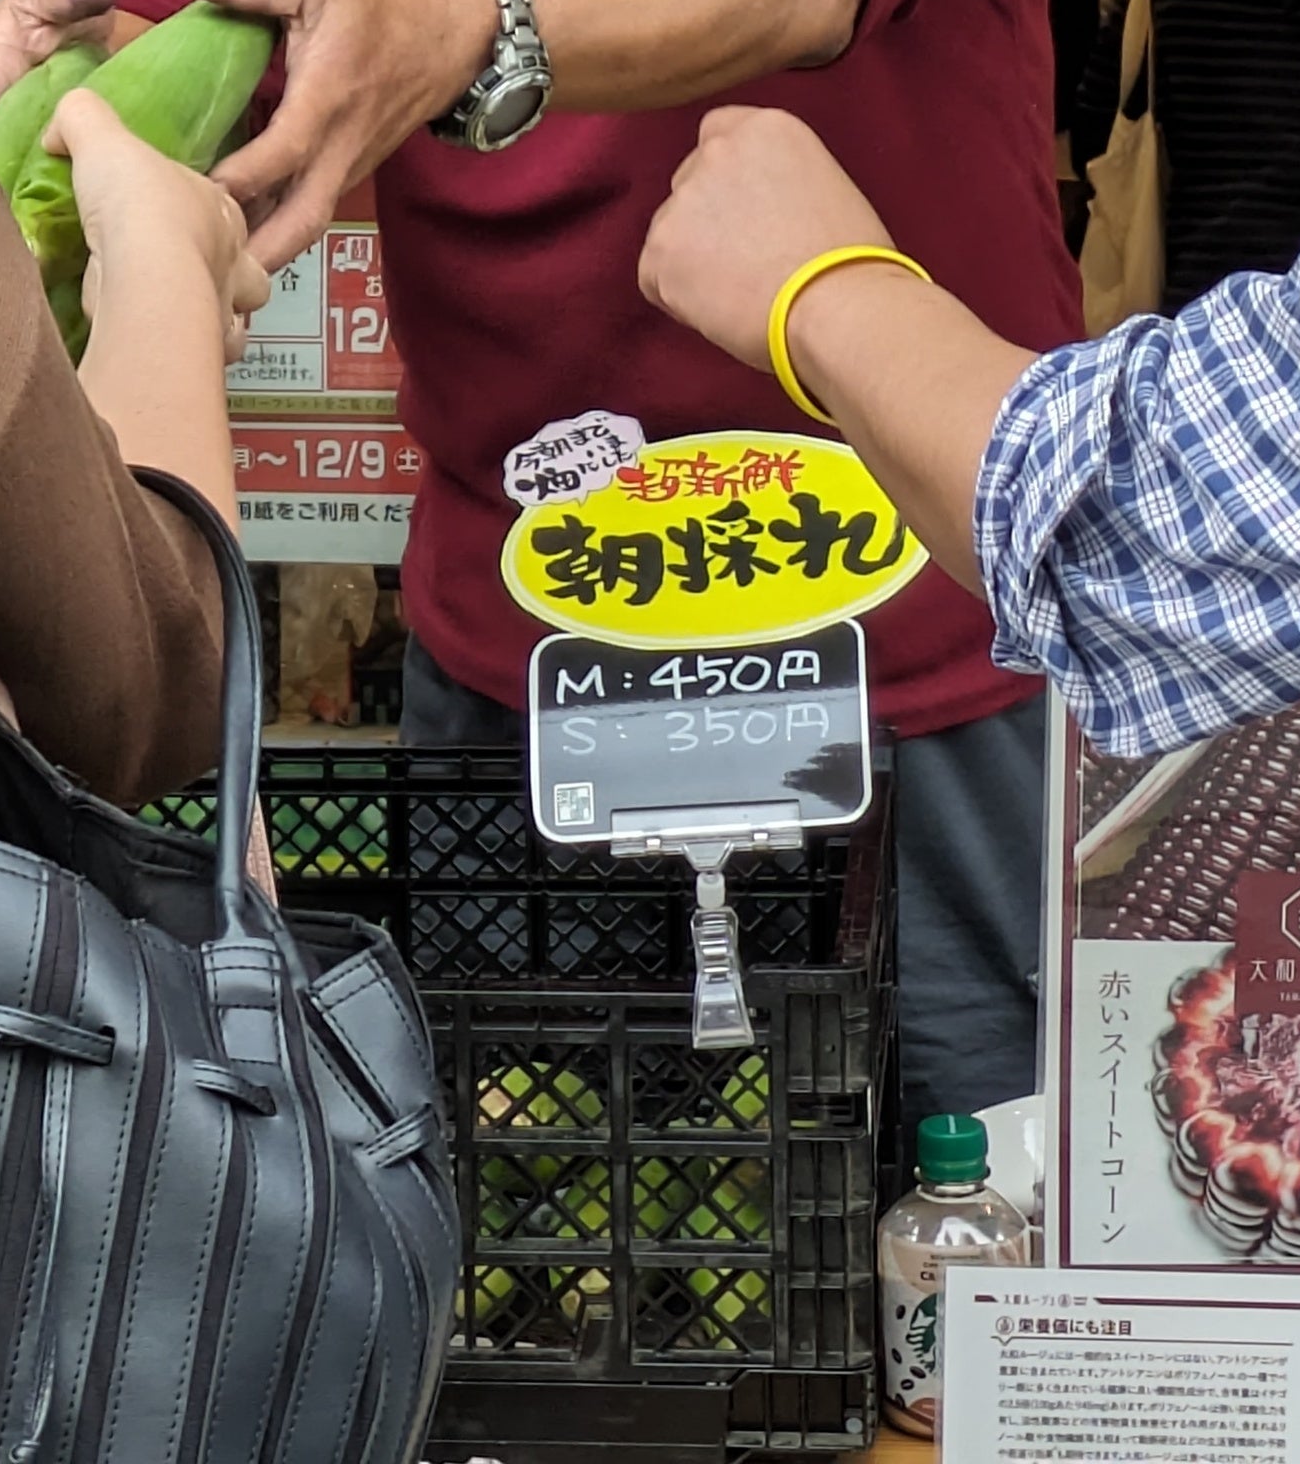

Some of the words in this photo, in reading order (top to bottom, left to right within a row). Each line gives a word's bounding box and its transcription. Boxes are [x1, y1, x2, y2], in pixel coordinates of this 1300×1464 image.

[531, 492, 906, 606] 朝採れ
[1097, 970, 1132, 1245] 赤いスイートコーン
